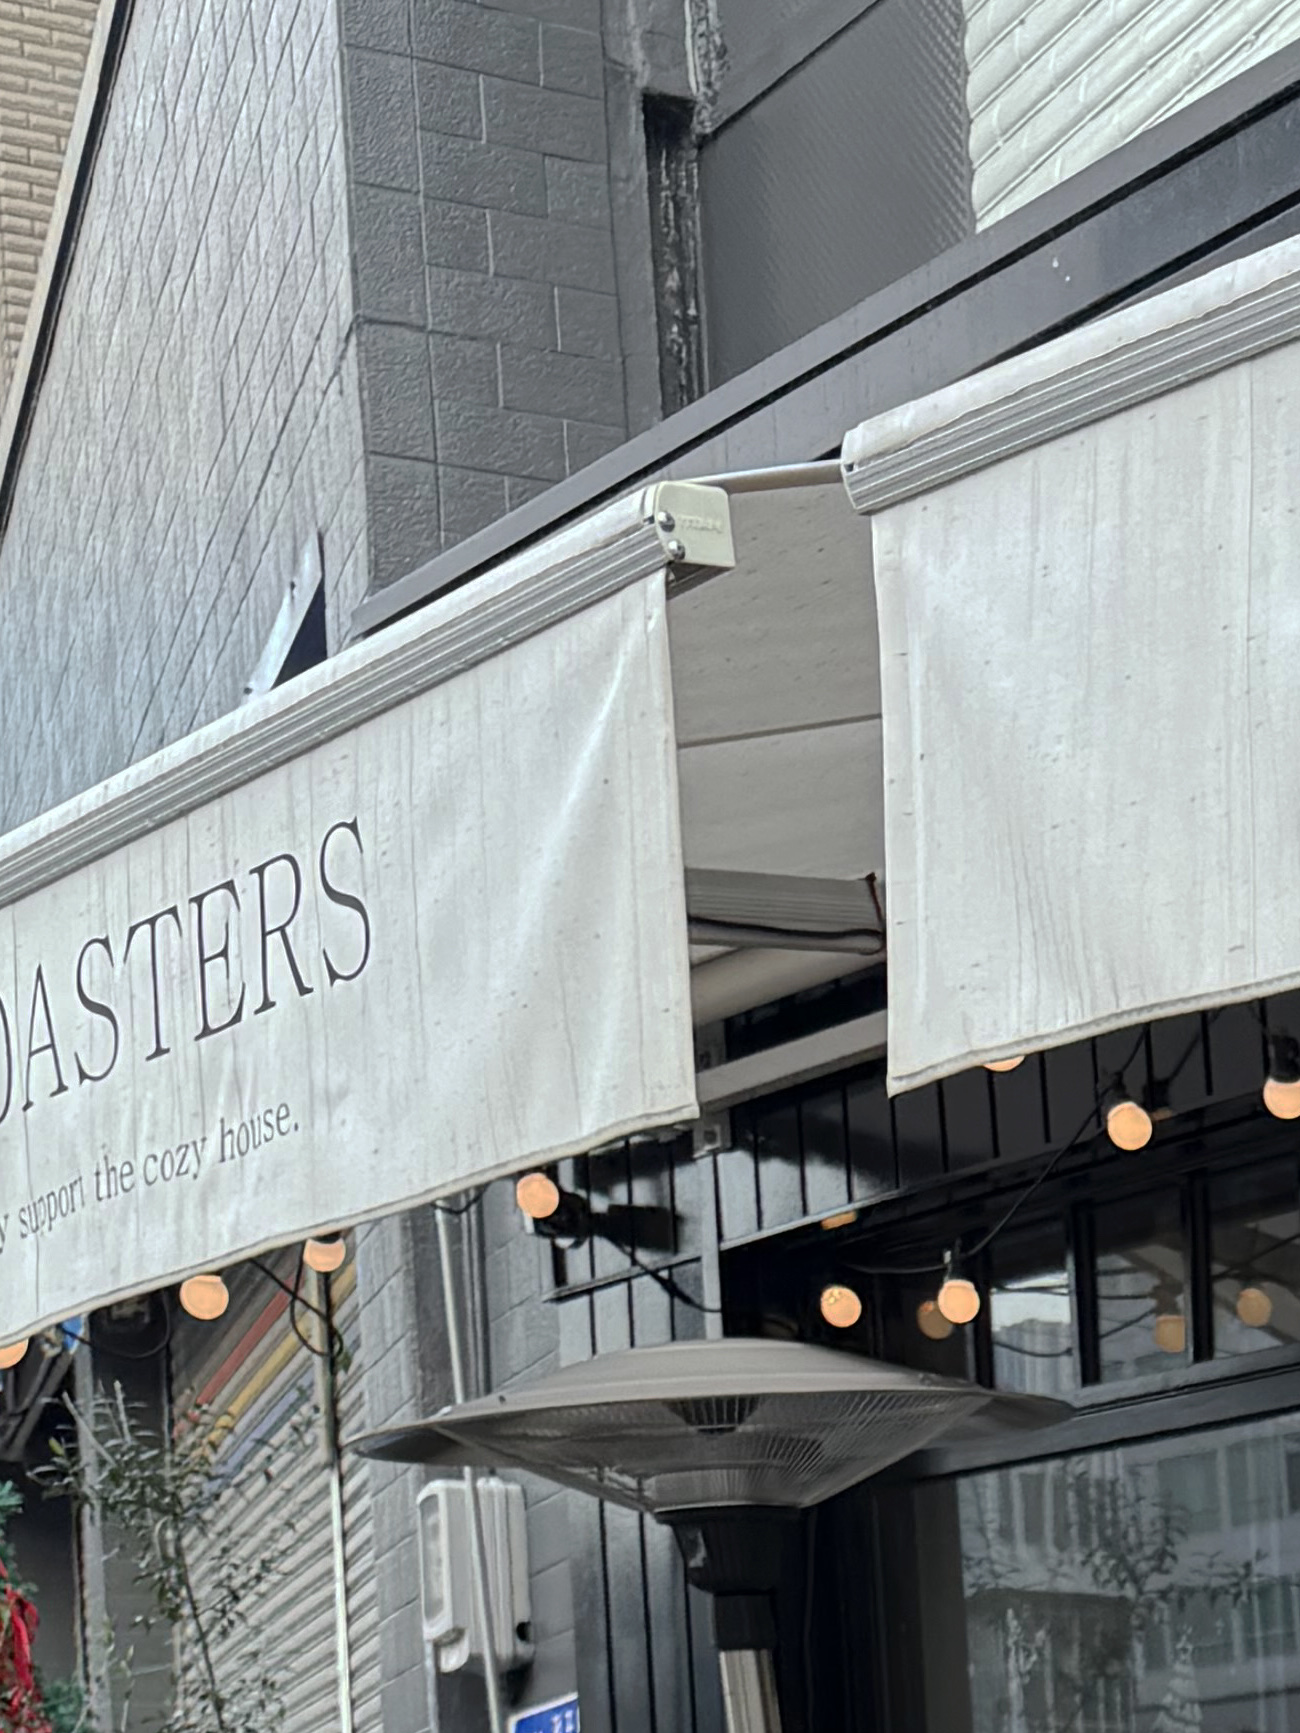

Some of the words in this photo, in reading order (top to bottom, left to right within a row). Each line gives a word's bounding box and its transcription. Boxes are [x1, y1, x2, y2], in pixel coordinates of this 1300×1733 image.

[0, 816, 371, 1124] ASTERS
[94, 1153, 136, 1202] the
[143, 1136, 208, 1181] cozy
[218, 1102, 300, 1164] house.
